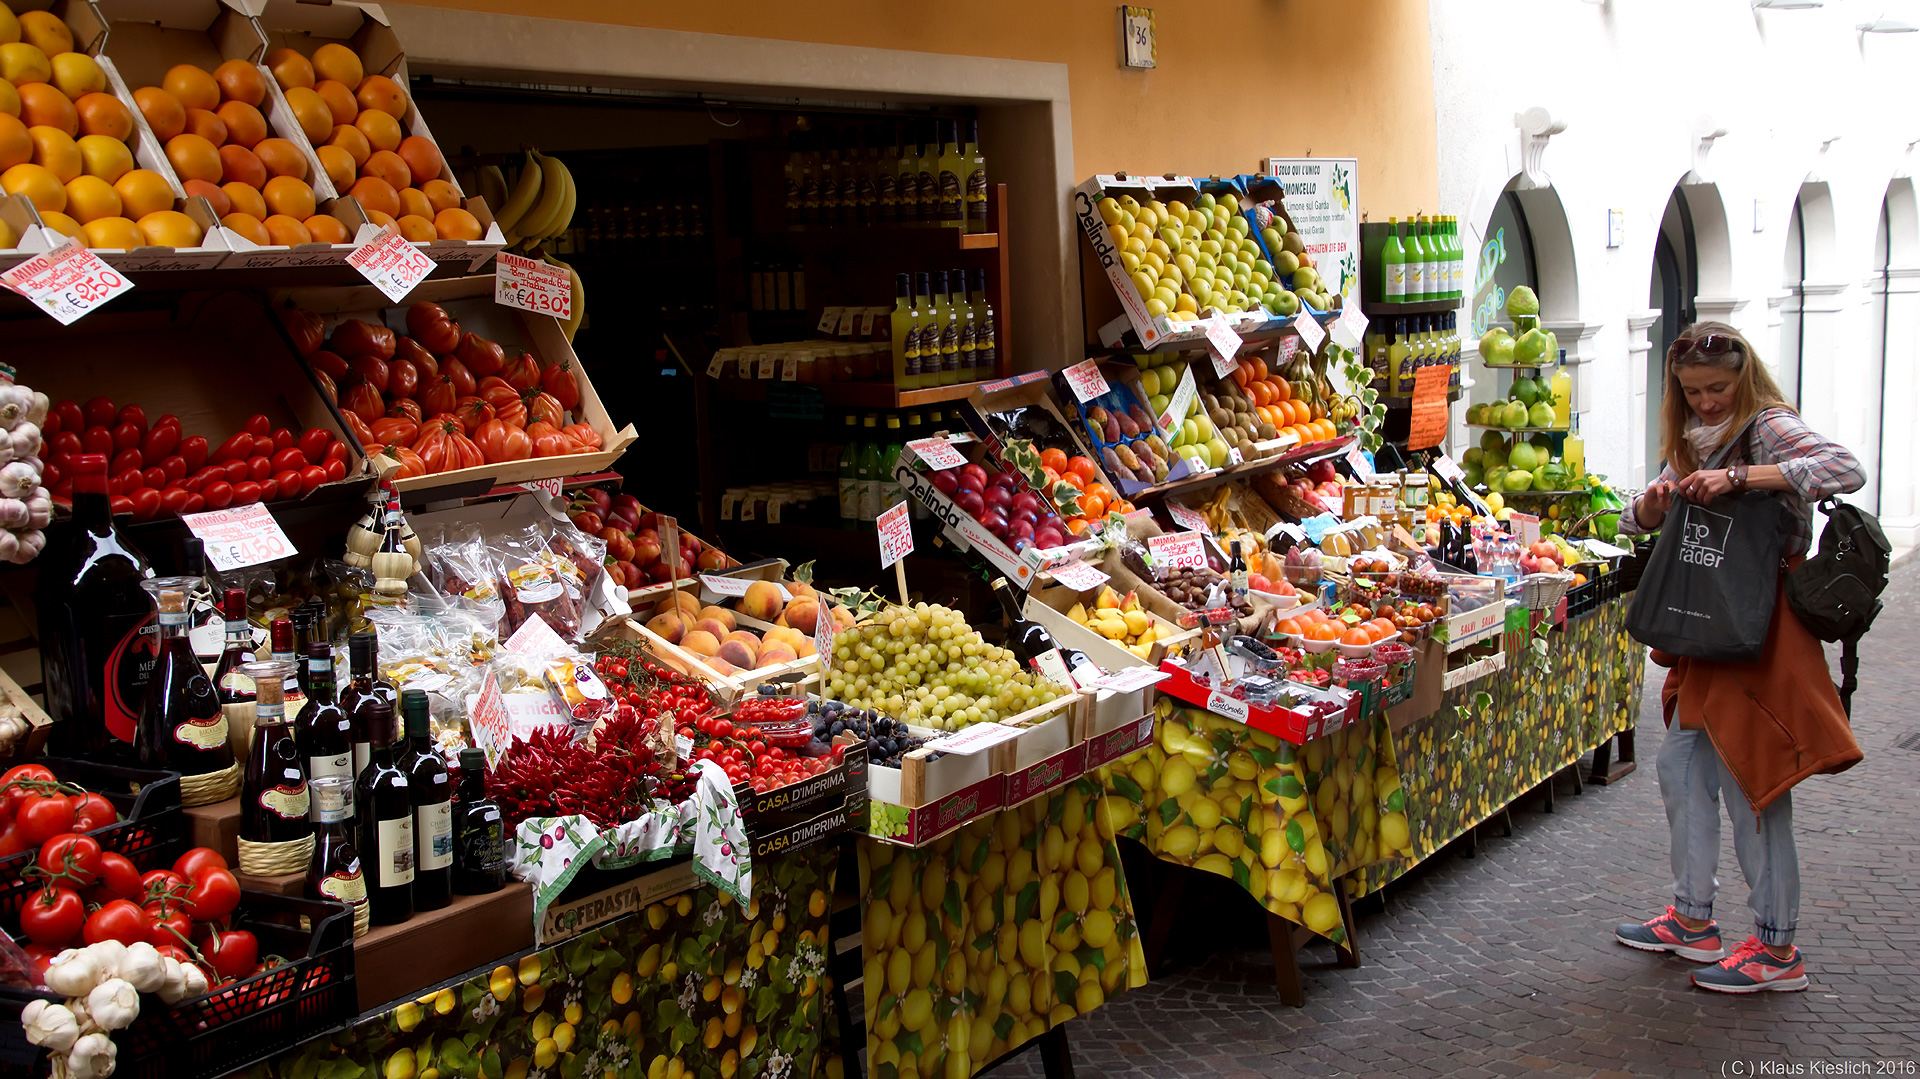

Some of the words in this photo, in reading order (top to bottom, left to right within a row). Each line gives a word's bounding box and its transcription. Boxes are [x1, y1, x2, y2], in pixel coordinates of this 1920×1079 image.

[1136, 26, 1147, 46] 36
[1283, 183, 1317, 195] IMONCELLO
[1075, 192, 1114, 269] Melinda
[351, 244, 376, 265] MIMO
[504, 254, 536, 270] MIMO
[11, 258, 49, 281] MIMO
[896, 465, 960, 529] Melinda
[192, 513, 228, 526] MIMO
[879, 511, 894, 525] MIMO
[1153, 536, 1176, 545] MIMO
[1679, 545, 1724, 568] räder
[1460, 621, 1476, 635] SALVI
[1482, 614, 1496, 628] SALVI
[508, 631, 528, 651] MIMO
[1503, 626, 1526, 656] IMO
[525, 700, 561, 715] nich
[190, 719, 206, 727] CARLO
[758, 793, 789, 812] CASA
[792, 772, 845, 802] D'IMPRIMA
[758, 835, 789, 856] CASA
[792, 813, 846, 844] D'IMPRIMA
